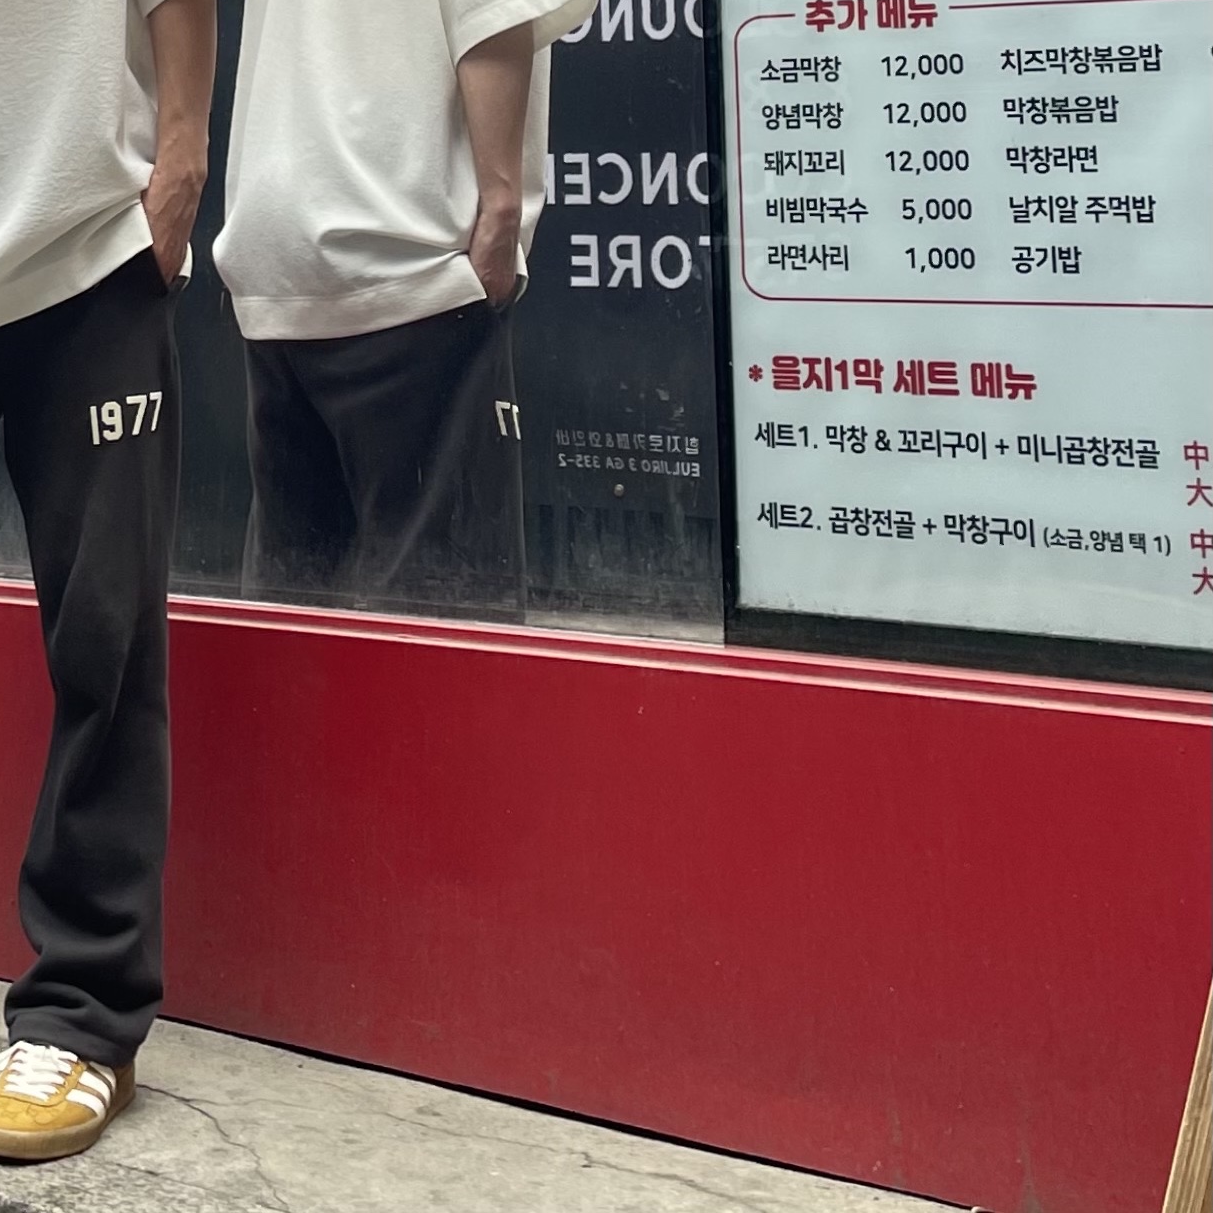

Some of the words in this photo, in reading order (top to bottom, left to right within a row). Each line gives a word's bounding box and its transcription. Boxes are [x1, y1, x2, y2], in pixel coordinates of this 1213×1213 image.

[760, 55, 842, 84] 소금막창
[881, 53, 964, 80] 12,000
[1000, 43, 1164, 76] 치즈막창볶음밥
[761, 102, 844, 131] 양념막창
[882, 101, 967, 128] 12,000
[1002, 94, 1120, 125] 막창볶음밥
[763, 149, 845, 177] 돼지꼬리
[884, 149, 970, 176] 12,000
[1005, 145, 1099, 175] 막창라면
[765, 196, 869, 224] 비빔막국수
[902, 198, 973, 225] 5,000
[1008, 195, 1079, 224] 날치알
[1084, 194, 1157, 224] 주먹밥
[767, 244, 849, 272] 라면사리
[904, 247, 976, 273] 1,000
[1011, 245, 1082, 275] 공기밥
[771, 355, 885, 394] 을지1막
[892, 359, 961, 397] 세트
[970, 361, 1038, 401] 메뉴
[89, 390, 163, 445] 1977
[754, 421, 818, 449] 세트1.
[825, 424, 869, 454] 막창
[874, 429, 893, 452] &
[897, 429, 987, 460] 꼬리구이
[994, 438, 1010, 456] +
[1017, 433, 1161, 470] 미니곱창전골
[1183, 440, 1210, 471] 中
[1185, 477, 1213, 508] 大
[756, 501, 821, 531] 세트2.
[828, 506, 916, 540] 곱창전골
[922, 518, 938, 535] +
[943, 513, 1036, 548] 막창구이
[1043, 526, 1124, 553] (소금,양념
[1128, 532, 1147, 555] 택
[1152, 534, 1172, 557] 1)
[1189, 528, 1213, 560] 中
[1191, 566, 1213, 596] 大
